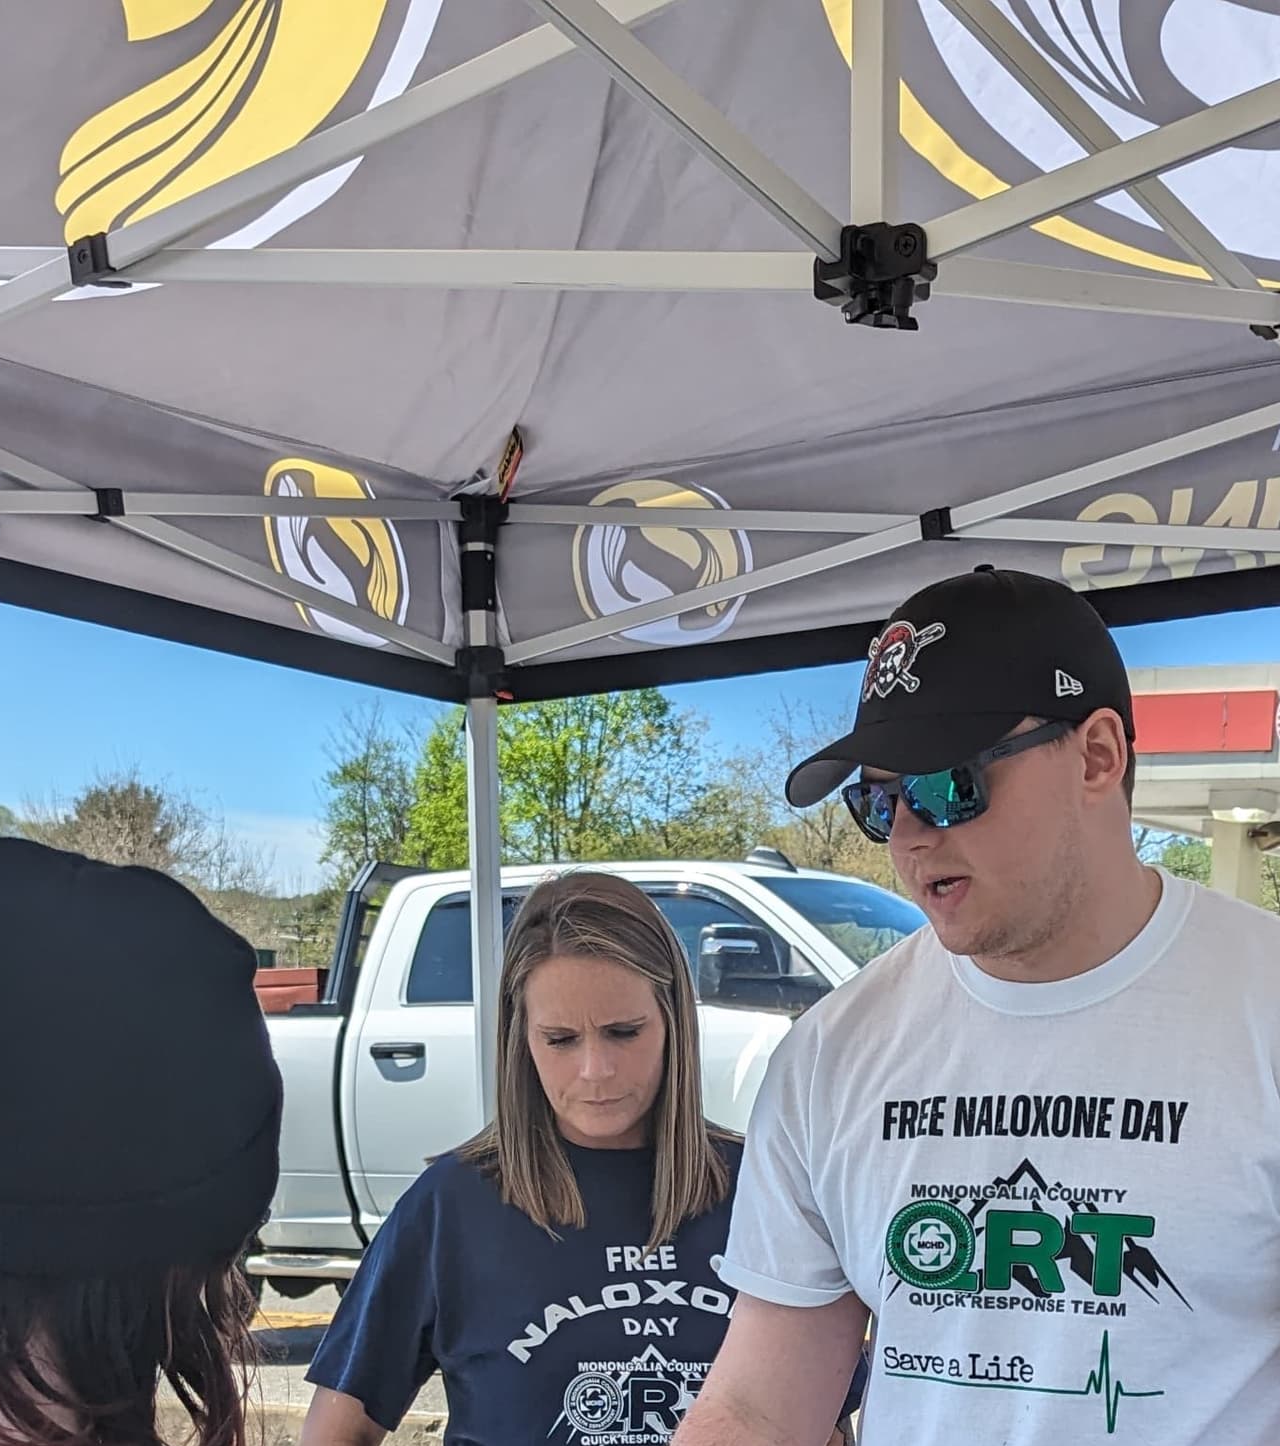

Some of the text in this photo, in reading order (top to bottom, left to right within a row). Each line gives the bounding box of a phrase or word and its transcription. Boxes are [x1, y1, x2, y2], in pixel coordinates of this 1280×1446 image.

[882, 1094, 1189, 1144] FREE NALOXONE DAY
[910, 1183, 1128, 1204] MONONGALIA COUNTY
[885, 1199, 1156, 1297] QRT
[917, 1240, 945, 1250] MCHD
[606, 1246, 677, 1272] FREE
[909, 1292, 1127, 1317] QUICK RESPONSE TEAM
[507, 1279, 737, 1364] NALOXO
[622, 1318, 680, 1337] DAY
[578, 1361, 712, 1373] MONONGALIA COUNT
[884, 1347, 1035, 1383] Save a Life
[581, 1434, 620, 1446] QUICK
